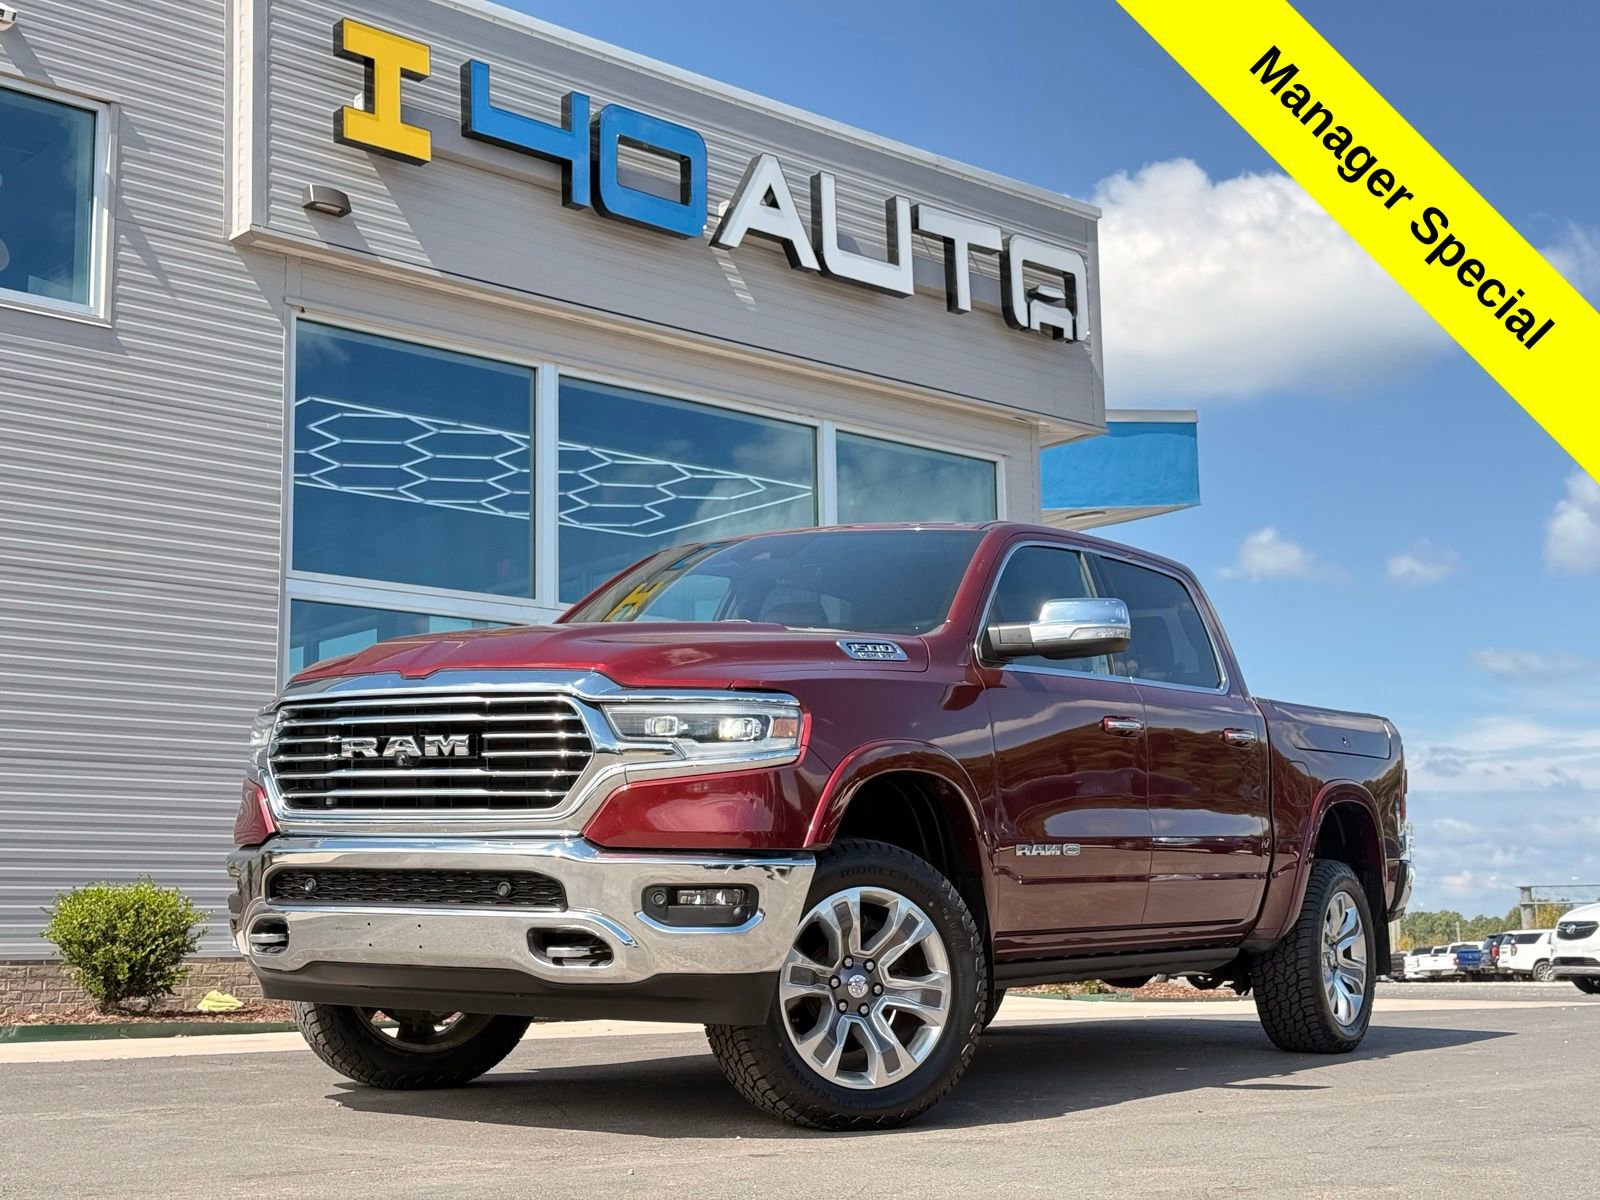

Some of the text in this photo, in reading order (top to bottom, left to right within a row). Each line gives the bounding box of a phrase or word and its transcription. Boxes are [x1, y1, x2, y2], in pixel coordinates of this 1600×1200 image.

[848, 643, 894, 653] 1500
[341, 733, 470, 758] RAM
[1015, 843, 1063, 857] RAM
